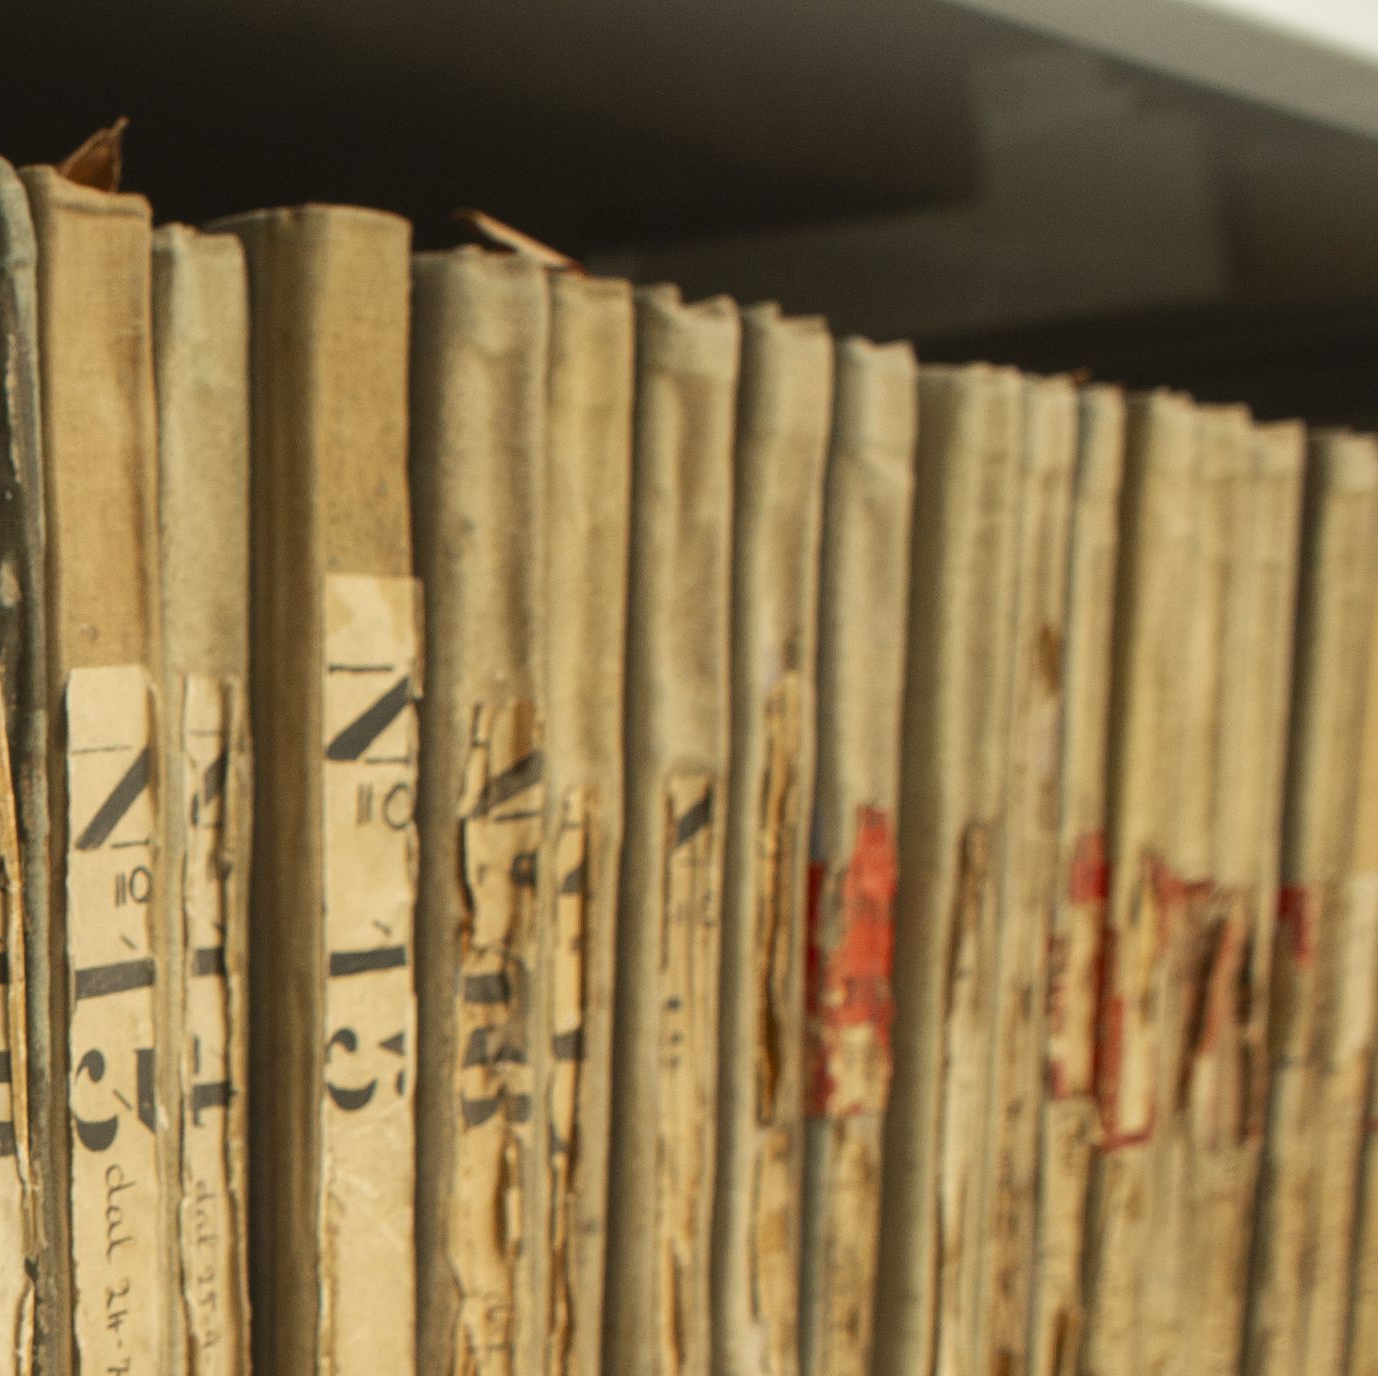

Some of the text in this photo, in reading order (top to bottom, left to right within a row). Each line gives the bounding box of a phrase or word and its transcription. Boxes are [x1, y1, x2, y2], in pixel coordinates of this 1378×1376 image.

[74, 936, 157, 1153] 13
[324, 921, 406, 1112] 15
[103, 1163, 136, 1261] dal
